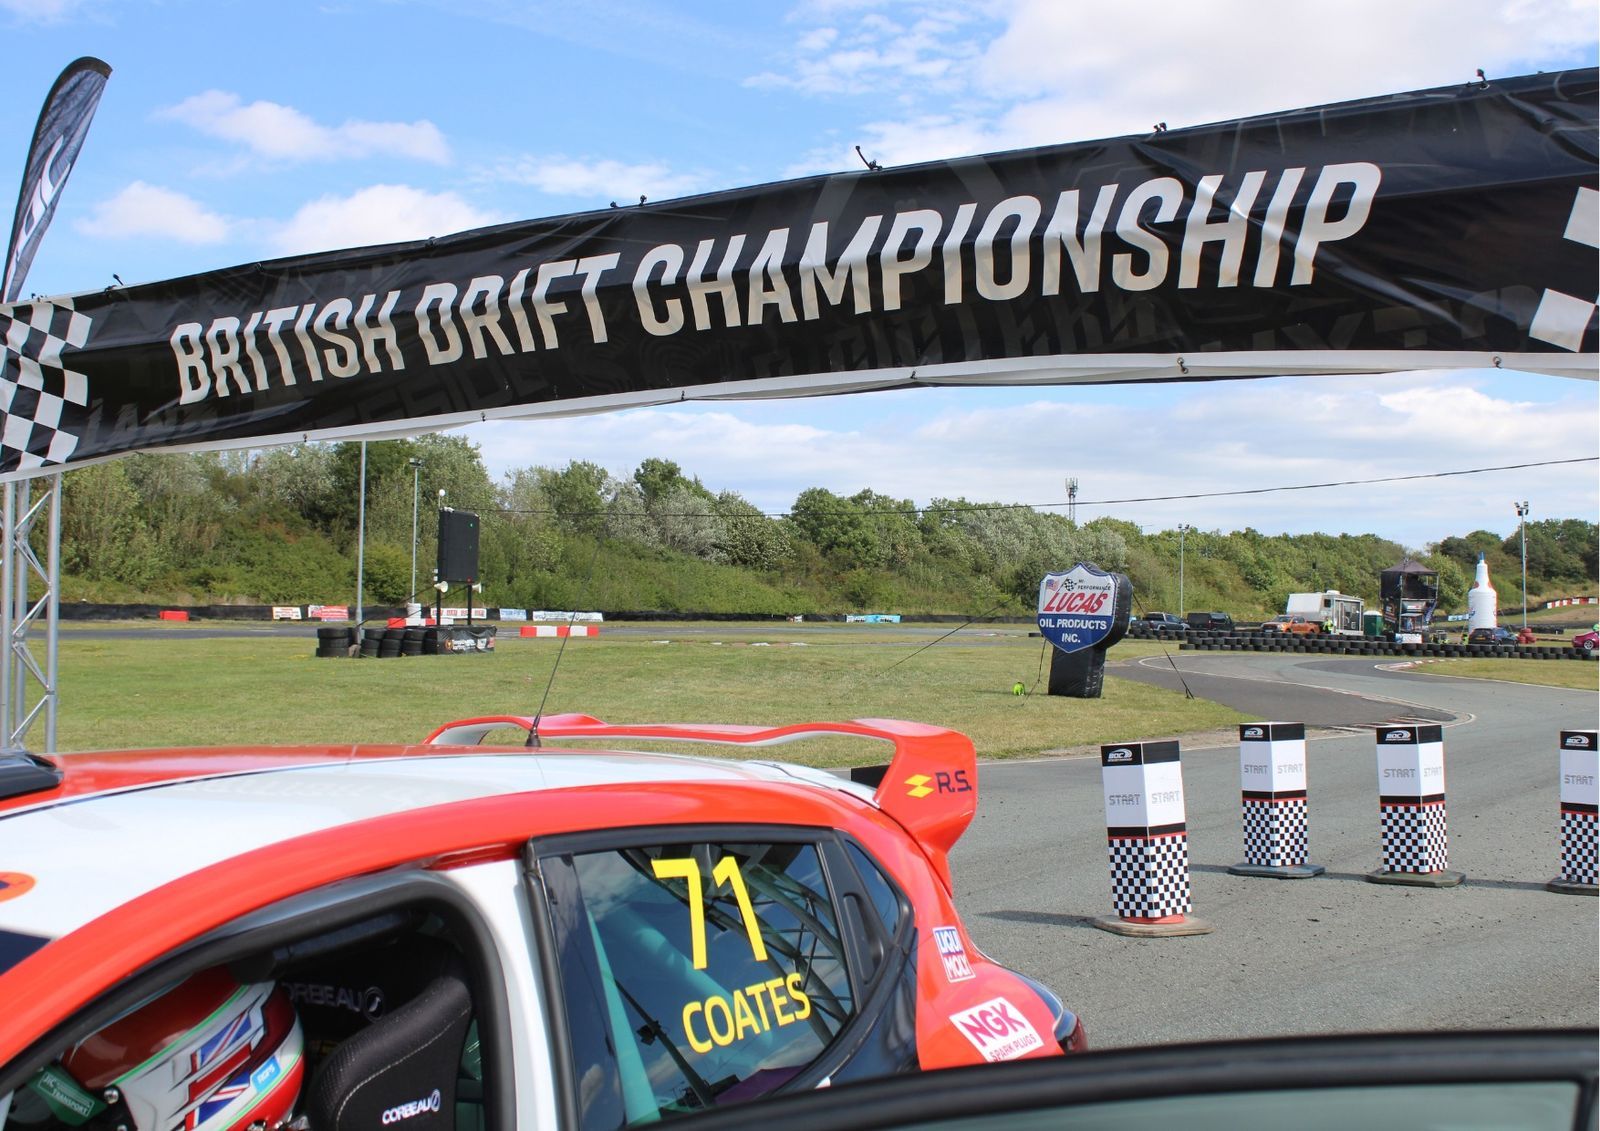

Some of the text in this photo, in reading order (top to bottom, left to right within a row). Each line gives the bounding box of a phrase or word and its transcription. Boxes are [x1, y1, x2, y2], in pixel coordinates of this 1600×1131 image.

[170, 290, 405, 405] BRITISH
[414, 253, 620, 366] DRIFT
[632, 162, 1382, 338] CHAMPIONSHIP
[1043, 592, 1108, 613] LUCAS
[1040, 618, 1107, 630] OIL PRODUCTS
[1061, 633, 1080, 643] INC.
[1244, 764, 1268, 775] START
[1277, 763, 1303, 775] START
[1383, 768, 1416, 778] START
[1423, 766, 1442, 778] START
[1564, 774, 1595, 786] START
[1108, 794, 1140, 806] START
[1151, 791, 1180, 805] START
[651, 856, 768, 970] 71
[943, 954, 973, 979] MOLY
[281, 982, 362, 1013] ORBEAU
[682, 973, 811, 1053] COATES
[960, 1002, 1026, 1047] NGK
[989, 1034, 1037, 1062] SPARK PLUGS
[382, 1097, 431, 1125] CORBEAU
